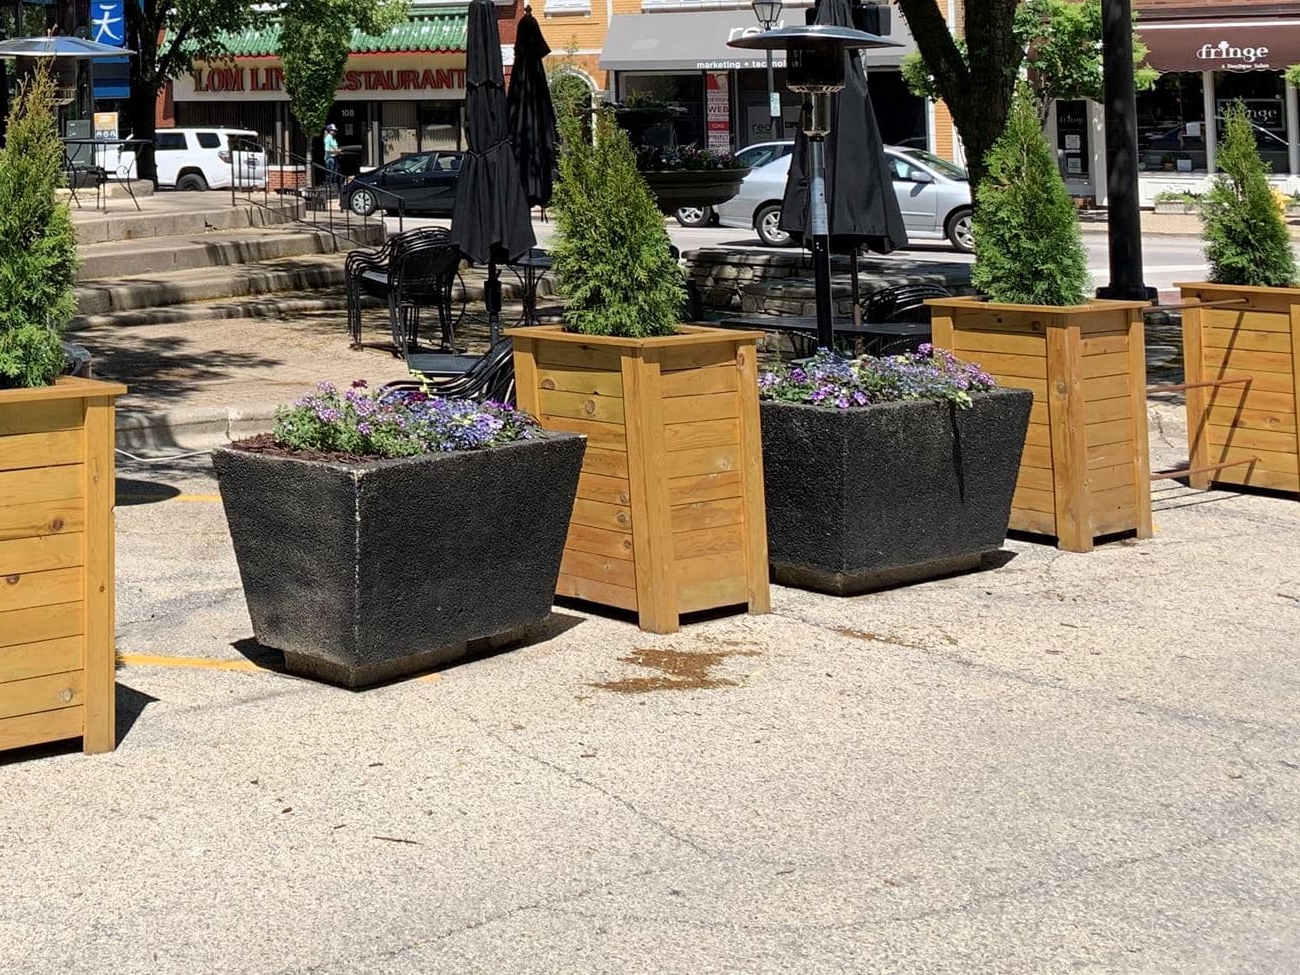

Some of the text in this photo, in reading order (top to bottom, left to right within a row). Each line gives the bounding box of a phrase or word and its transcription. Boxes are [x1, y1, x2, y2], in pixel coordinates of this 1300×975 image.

[1196, 41, 1268, 62] fringe
[696, 60, 740, 69] marketing
[194, 68, 245, 92] LOM
[249, 67, 284, 91] LIN
